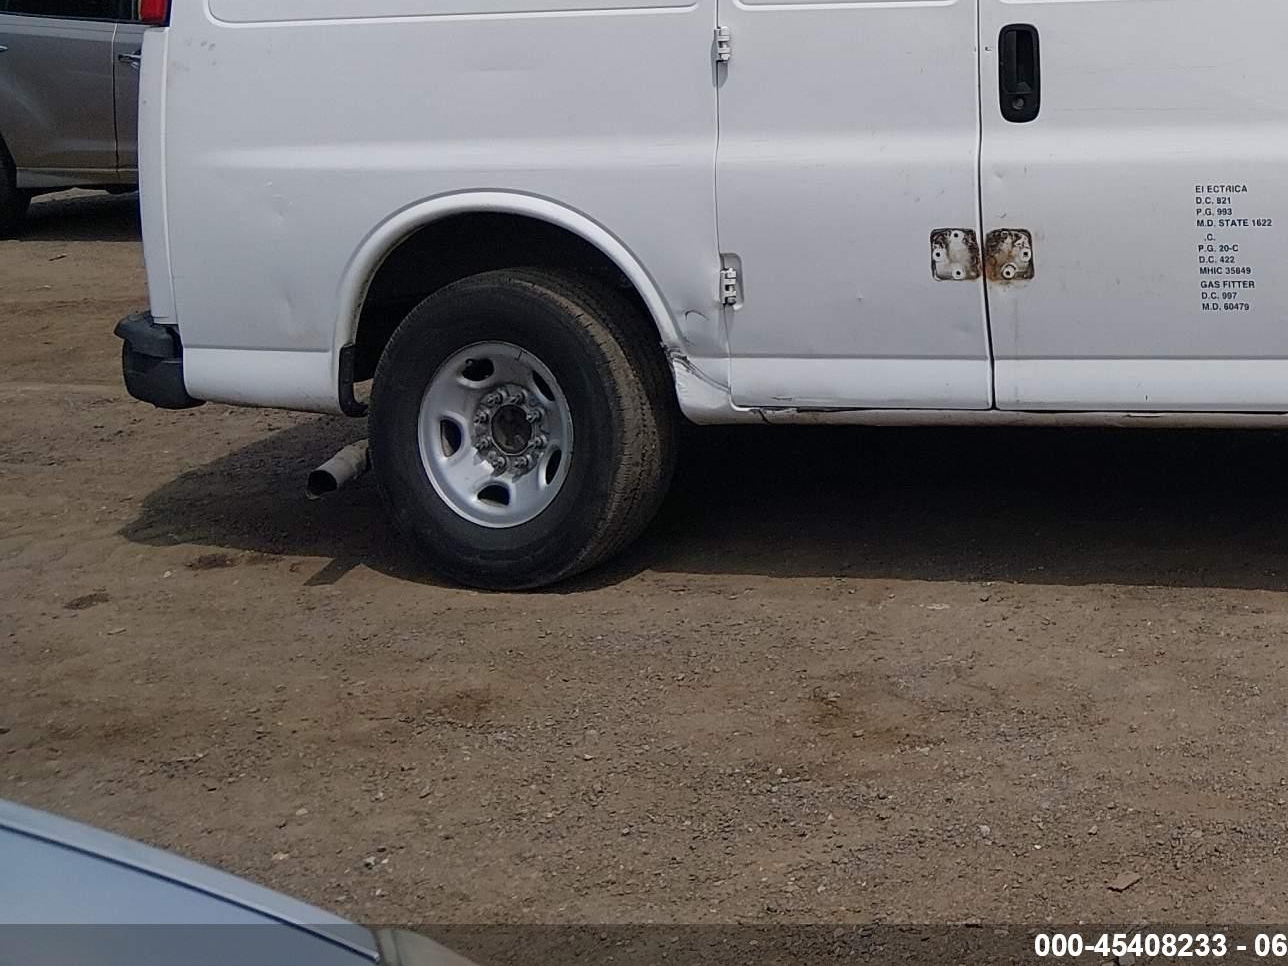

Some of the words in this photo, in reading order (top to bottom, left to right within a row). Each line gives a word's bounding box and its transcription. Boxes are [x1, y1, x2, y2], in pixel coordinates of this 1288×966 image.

[1195, 196, 1214, 205] D.C.
[1196, 208, 1215, 216] P.G.
[1196, 219, 1216, 227] M.D.
[1218, 219, 1249, 227] STATE
[1251, 218, 1273, 227] 1622
[1198, 244, 1217, 252] P.G.
[1218, 244, 1239, 252] 20-C
[1199, 255, 1217, 264] D.C.
[1219, 255, 1235, 264] 422
[1199, 266, 1223, 275] MHIC
[1200, 280, 1221, 289] GAS
[1222, 280, 1255, 289] FITTER
[1201, 291, 1220, 300] D.C.
[1202, 302, 1222, 311] M.D.
